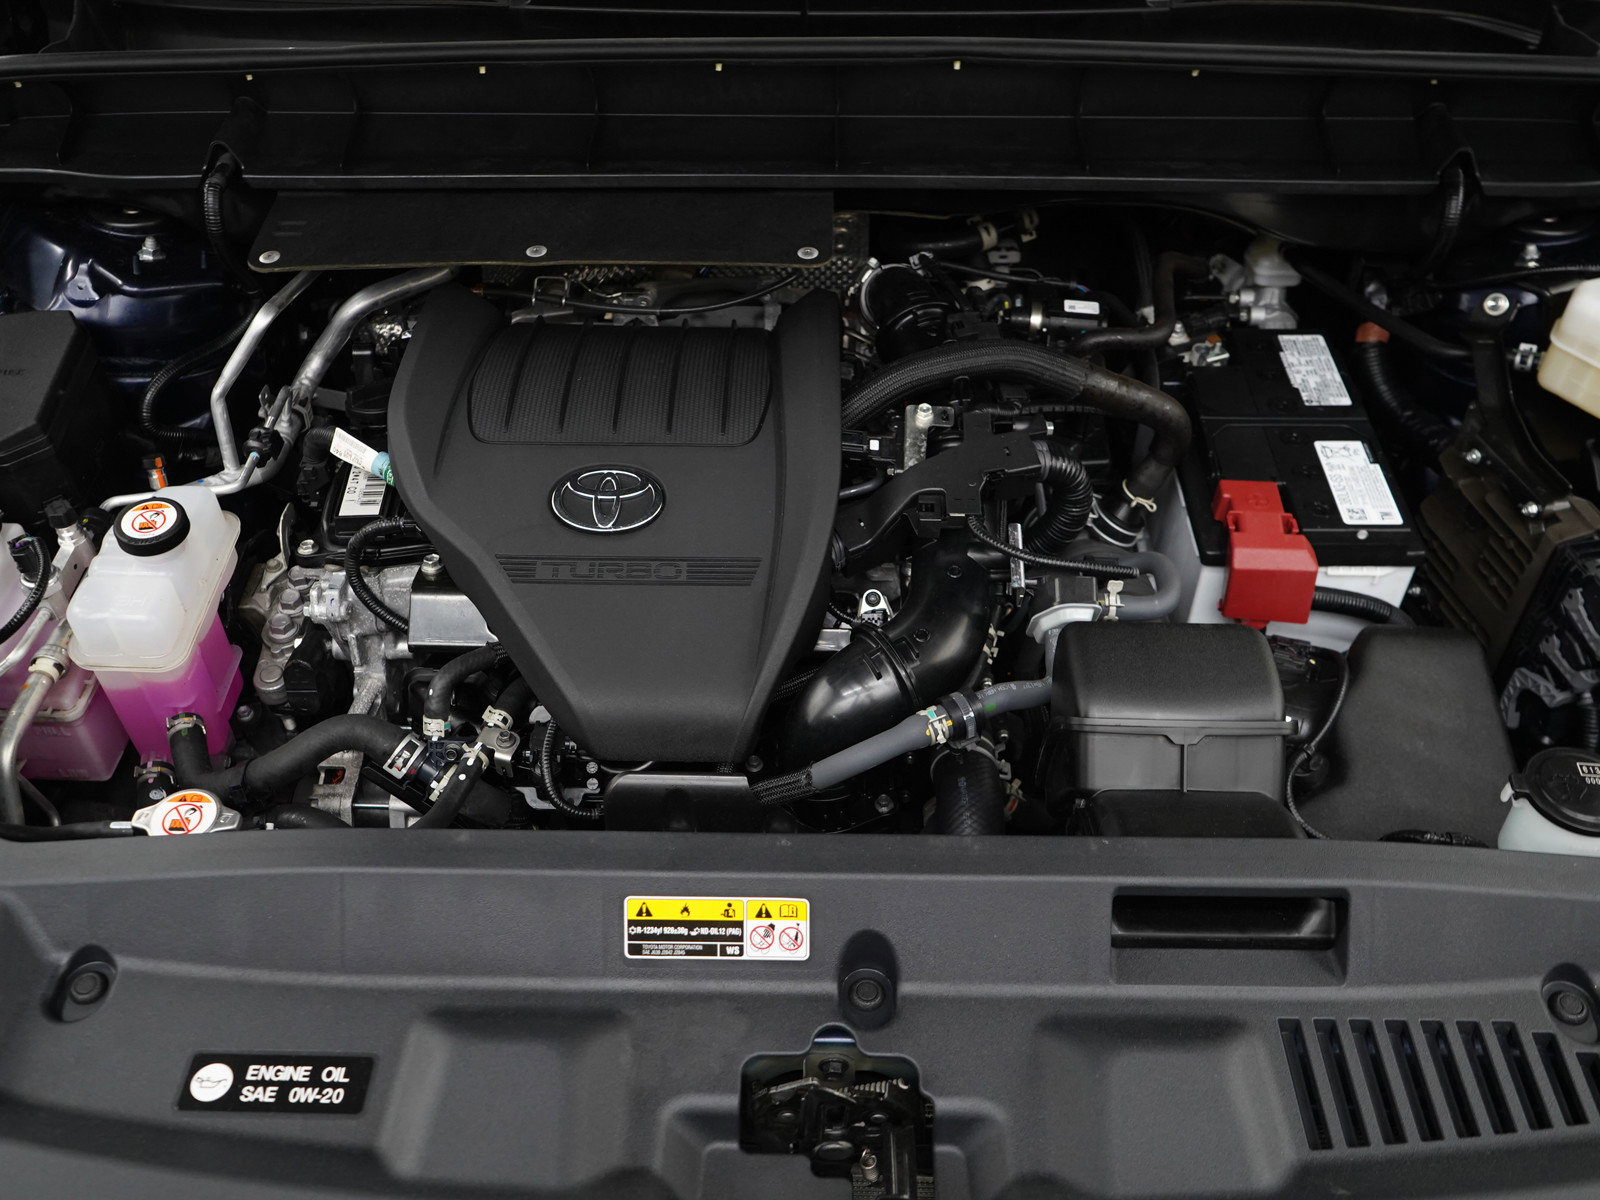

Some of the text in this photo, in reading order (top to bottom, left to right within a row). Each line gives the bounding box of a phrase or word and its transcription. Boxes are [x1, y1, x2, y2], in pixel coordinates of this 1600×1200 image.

[540, 561, 683, 580] TURBO
[726, 927, 742, 936] (PAG)
[725, 945, 740, 956] WS
[245, 1065, 350, 1083] ENGINE OIL
[239, 1086, 345, 1104] SAE 0W-20
